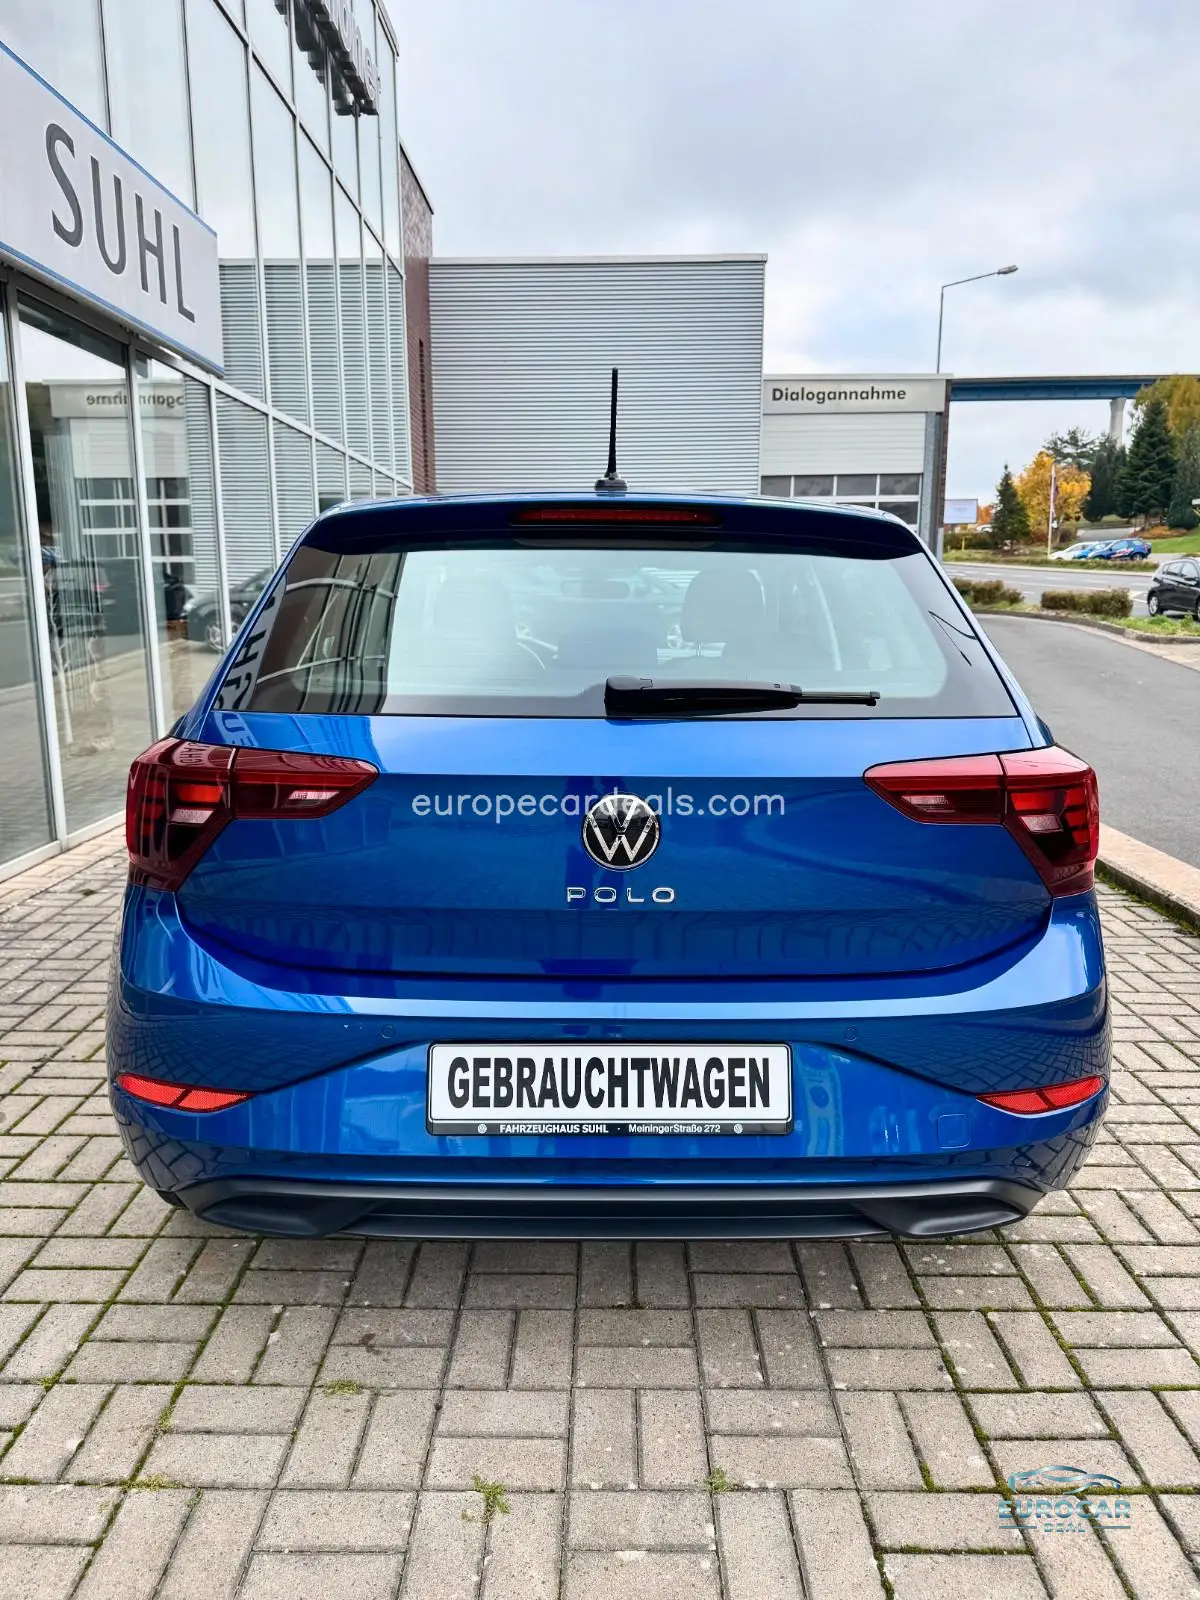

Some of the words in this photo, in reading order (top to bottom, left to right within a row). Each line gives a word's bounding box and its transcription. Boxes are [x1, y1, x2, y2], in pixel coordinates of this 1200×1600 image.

[45, 122, 196, 323] SUHL
[772, 386, 906, 404] Dialogannahme
[566, 886, 676, 904] POLO
[447, 1056, 771, 1109] GEBRAUCHTWAGEN
[499, 1124, 580, 1133] FAHRZEUGHAUS
[582, 1124, 609, 1133] SUHL
[704, 1124, 721, 1133] 272
